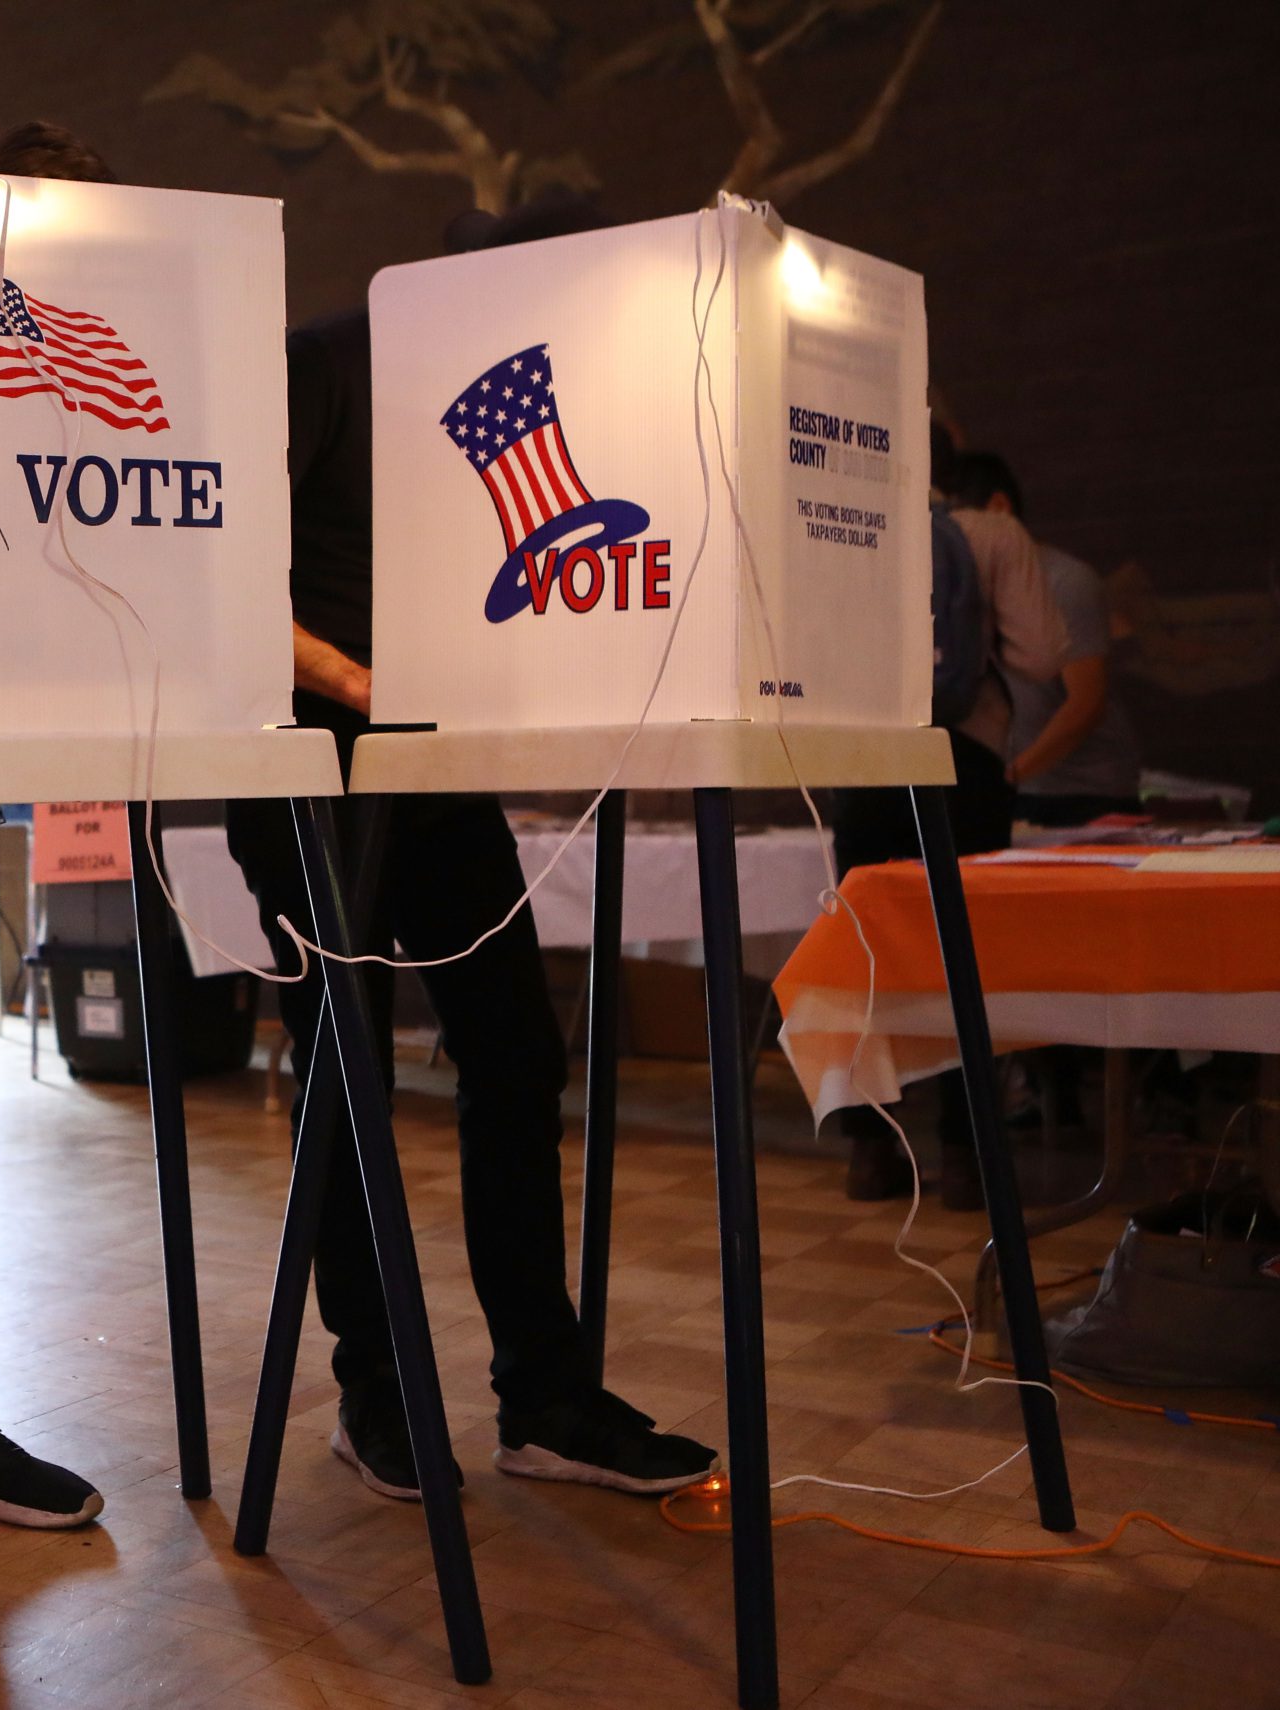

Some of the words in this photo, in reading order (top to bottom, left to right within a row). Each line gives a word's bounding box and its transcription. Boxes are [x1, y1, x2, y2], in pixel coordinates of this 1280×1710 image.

[789, 406, 840, 442] REGISTRAR
[842, 419, 854, 445] OF
[856, 422, 890, 453] VOTERS
[789, 437, 826, 470] COUNTY
[17, 454, 224, 528] VOTE
[797, 499, 813, 518] THIS
[814, 502, 839, 522] VOTING
[840, 506, 863, 526] BOOTH
[864, 510, 886, 530] SAVES
[806, 522, 847, 544] TAXPAYERS
[848, 529, 878, 549] DOLLARS
[524, 540, 671, 616] VOTE
[50, 803, 97, 815] BALLOT
[75, 822, 100, 834] FOR
